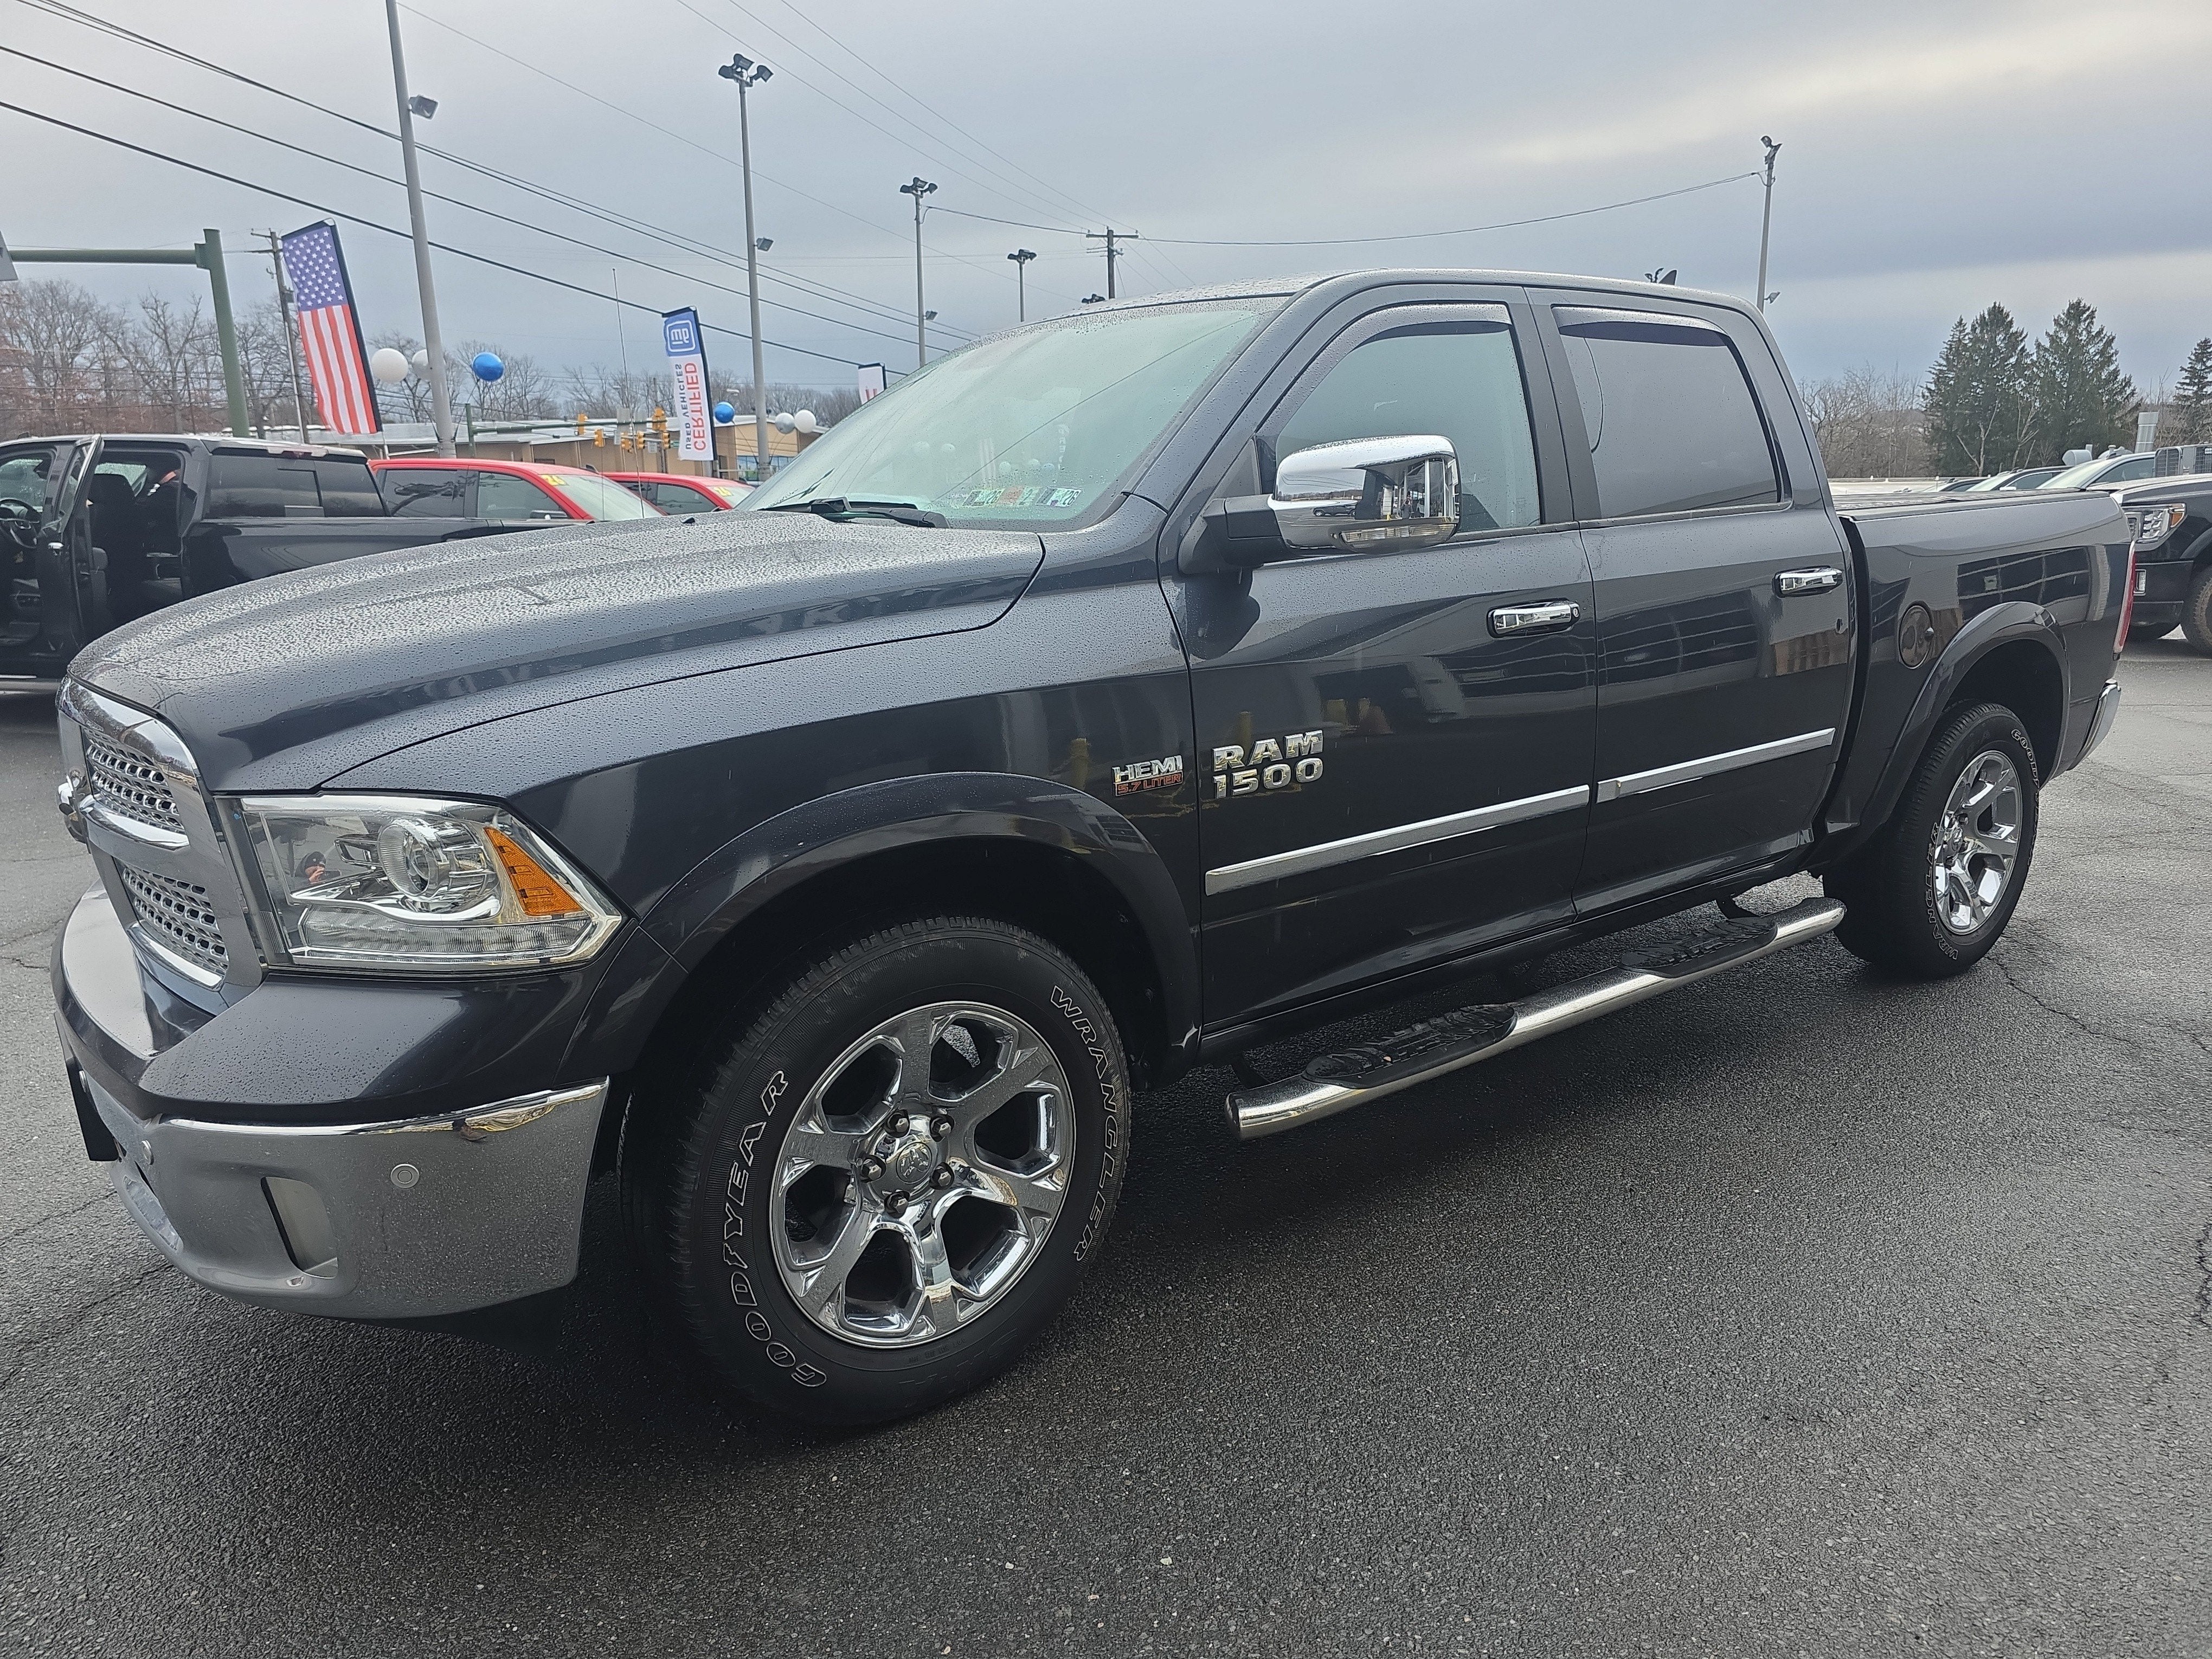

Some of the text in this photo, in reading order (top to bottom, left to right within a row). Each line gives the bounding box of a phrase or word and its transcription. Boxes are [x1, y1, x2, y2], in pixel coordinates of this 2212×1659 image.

[1112, 755, 1183, 782] HEMI
[1212, 730, 1323, 772] RAM
[1118, 773, 1181, 794] 5.7 LITER
[1213, 757, 1323, 799] 1500
[1926, 822, 1958, 960] WRANGLER
[1050, 985, 1118, 1262] WRANGLER
[722, 1070, 827, 1387] GOODYEAR
